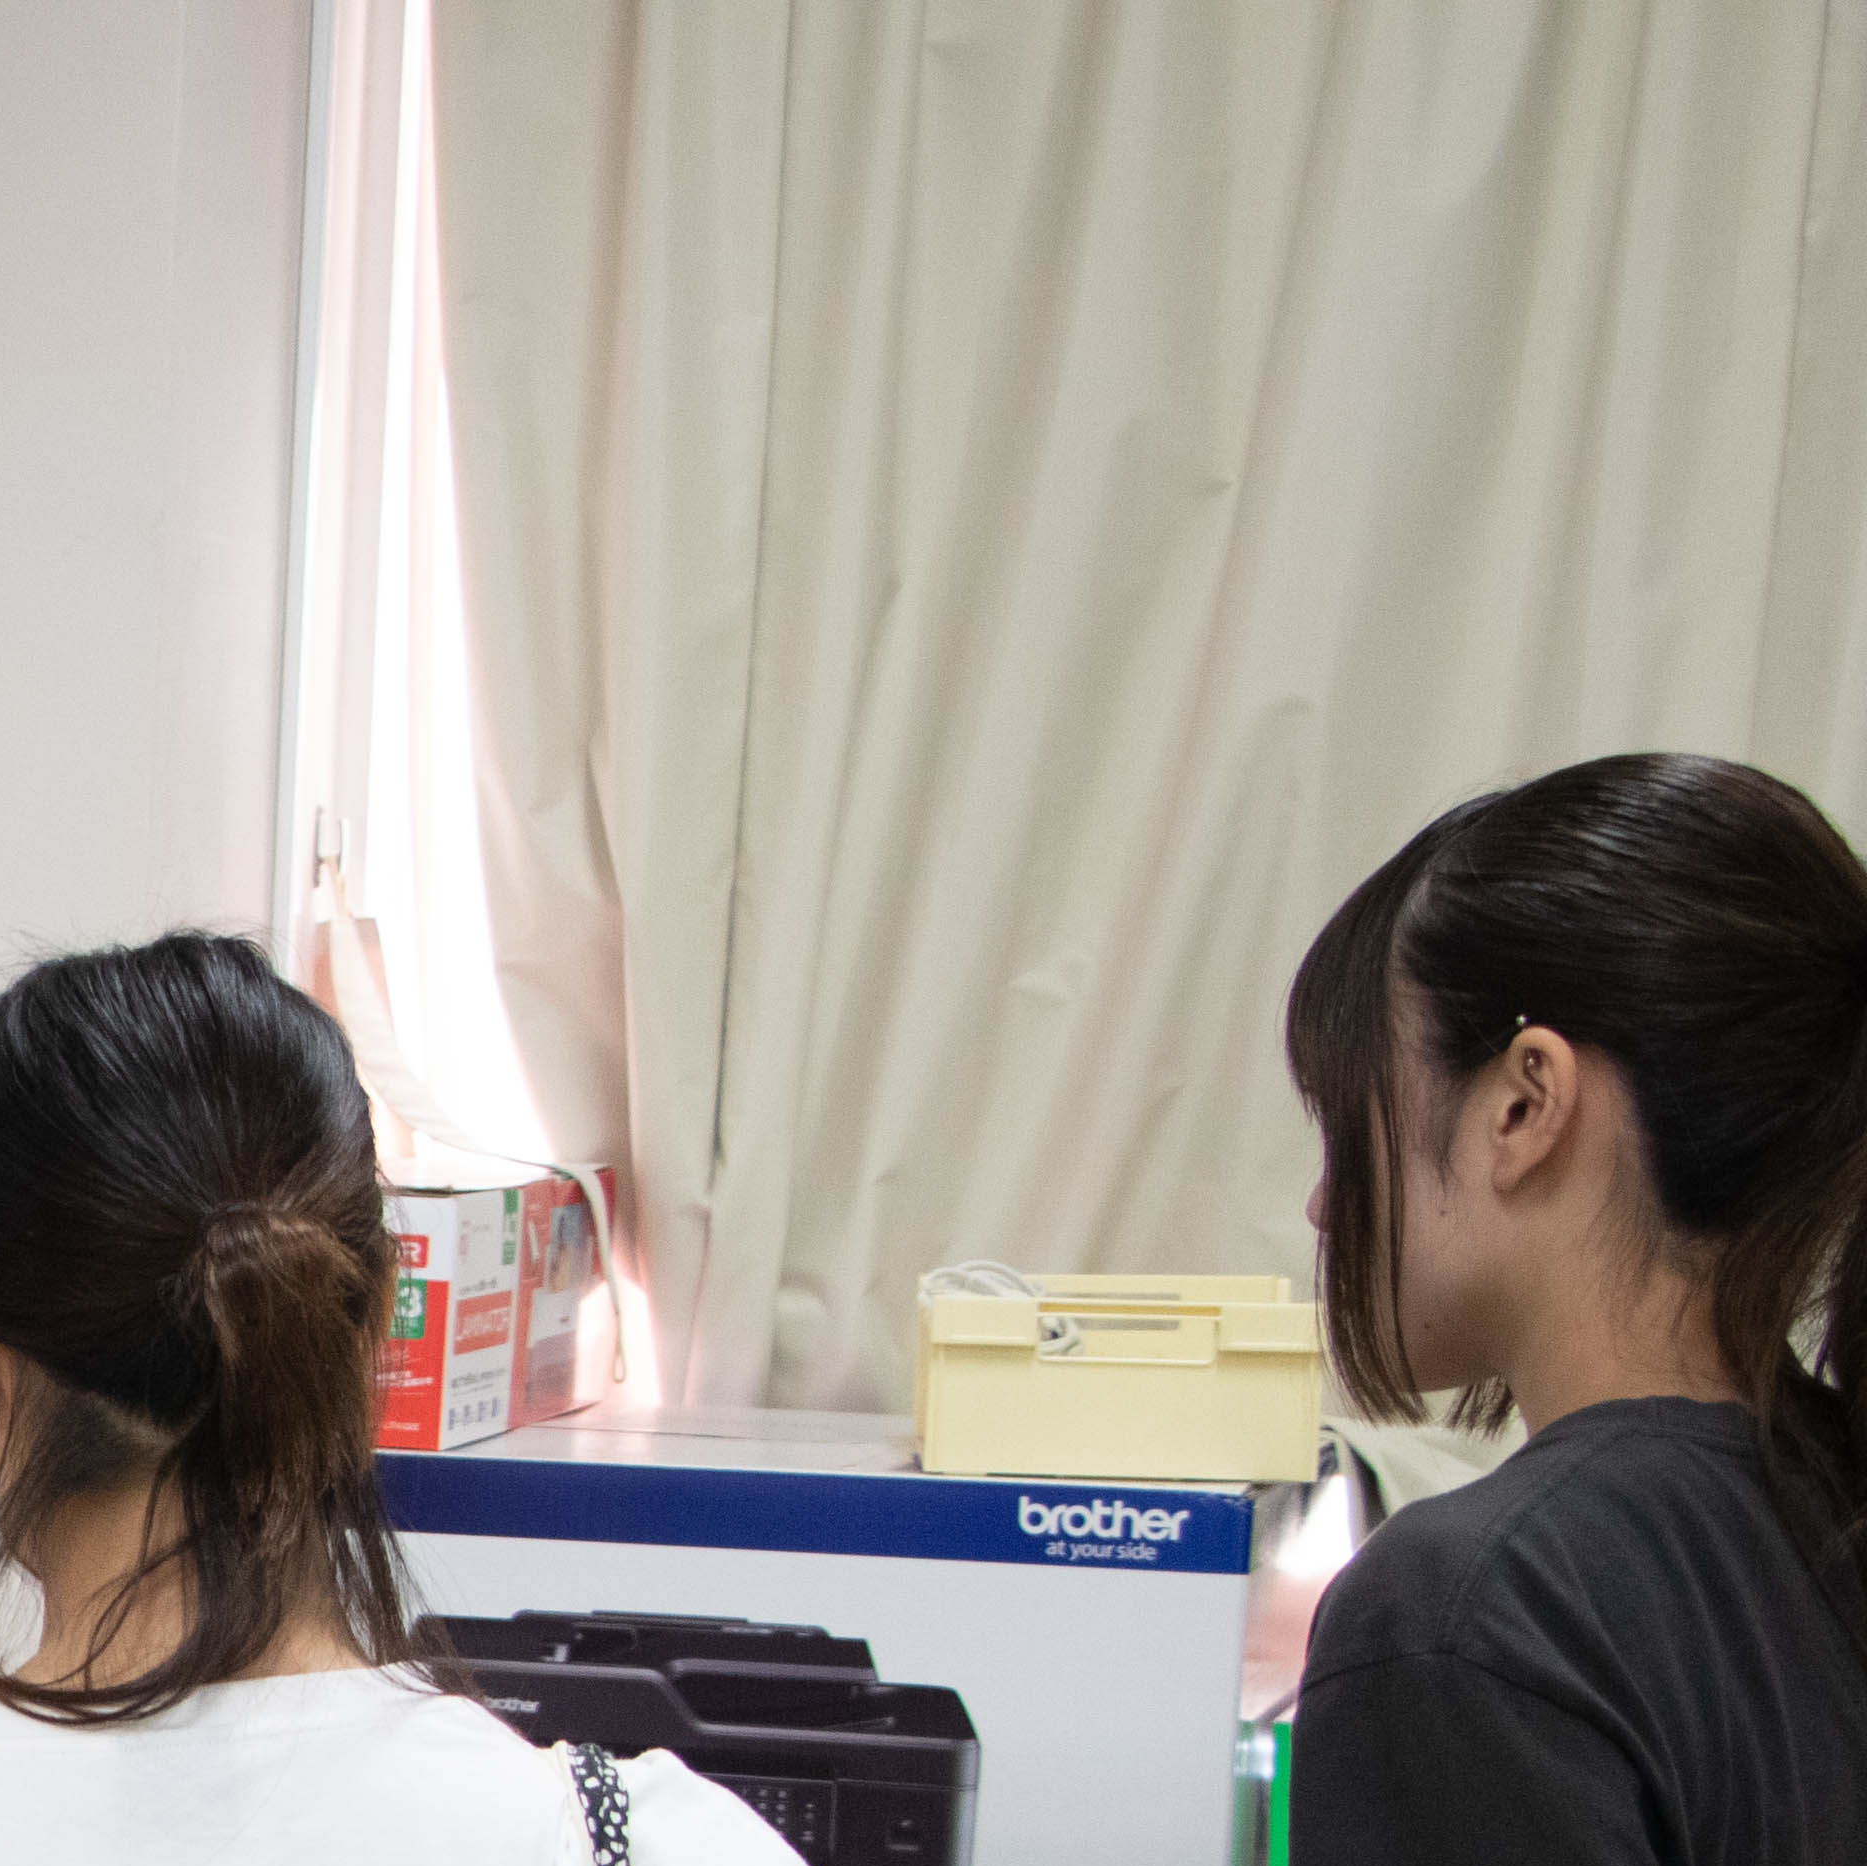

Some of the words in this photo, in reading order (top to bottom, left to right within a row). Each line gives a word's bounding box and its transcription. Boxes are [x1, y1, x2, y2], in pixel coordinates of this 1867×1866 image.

[1018, 1496, 1190, 1541] brother
[1045, 1540, 1067, 1557] at
[1070, 1542, 1115, 1561] your
[1116, 1541, 1158, 1561] side
